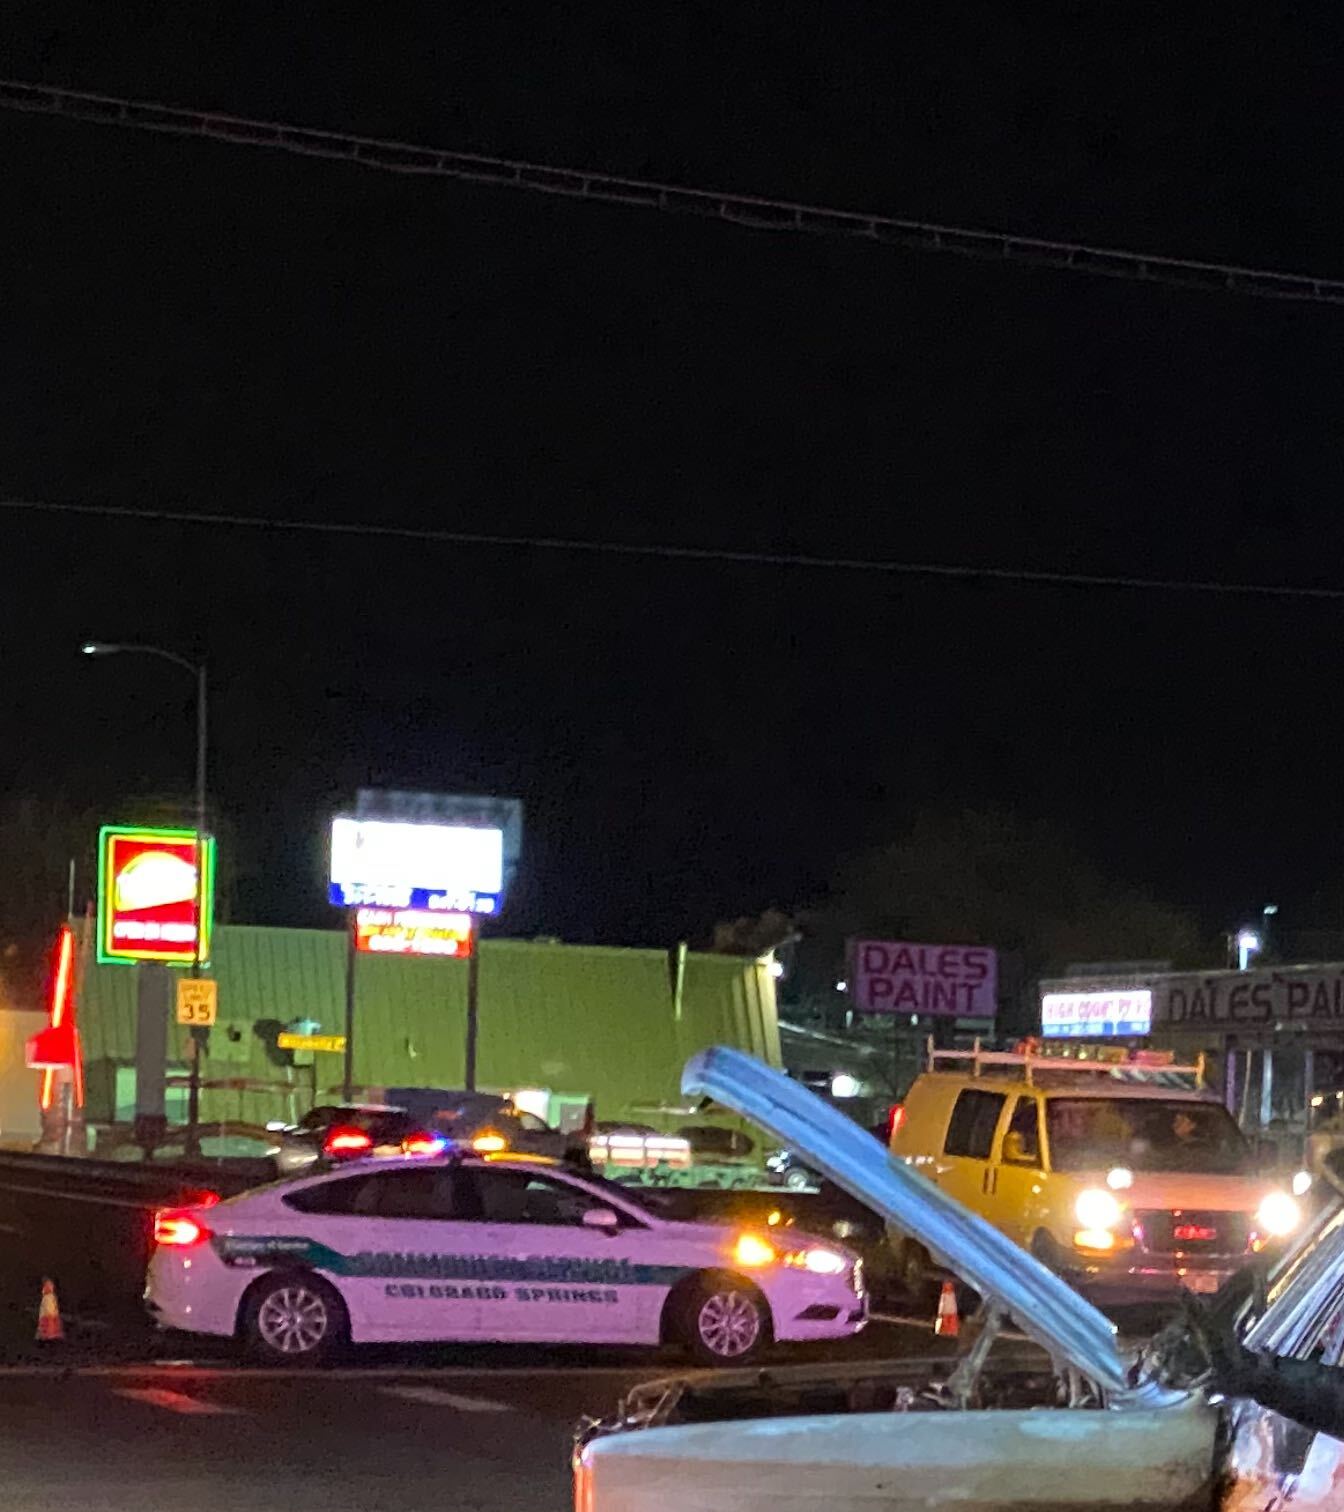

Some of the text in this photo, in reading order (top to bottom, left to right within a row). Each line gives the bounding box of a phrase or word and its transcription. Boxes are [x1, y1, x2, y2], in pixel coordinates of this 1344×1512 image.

[863, 945, 989, 979] DALES
[868, 977, 983, 1012] PAINT
[1168, 983, 1273, 1024] DALES
[183, 1003, 210, 1021] 35
